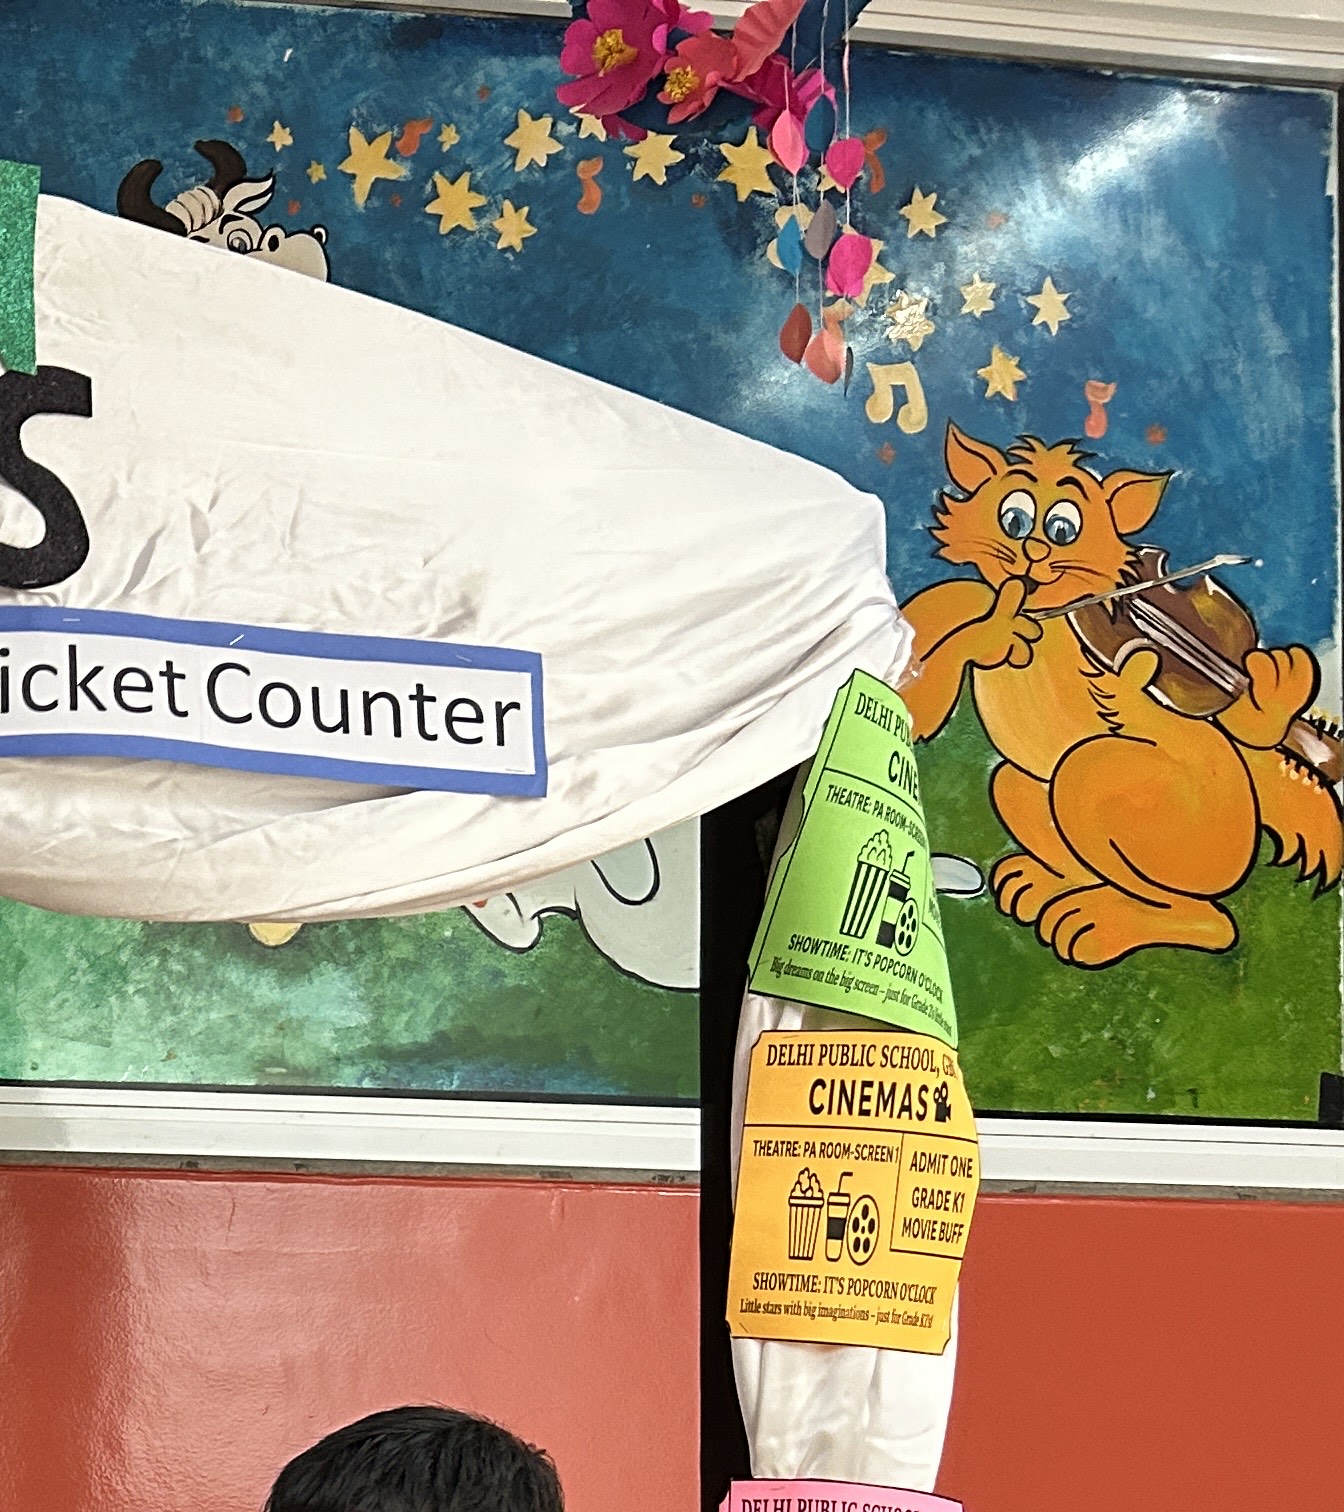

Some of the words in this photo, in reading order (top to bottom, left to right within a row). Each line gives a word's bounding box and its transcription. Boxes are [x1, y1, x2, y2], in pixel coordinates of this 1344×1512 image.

[206, 662, 521, 746] Counter
[855, 692, 894, 732] DELHI
[825, 784, 872, 813] THEATRE:
[872, 800, 884, 819] PA
[788, 934, 851, 962] SHOWTIME:
[852, 949, 873, 968] IT'S
[873, 954, 918, 983] POPCORN
[766, 1044, 815, 1067] DELHI
[817, 1044, 876, 1067] PUBLIC
[880, 1045, 940, 1078] SCHOOL,
[809, 1078, 929, 1121] CINEMAS
[753, 1140, 802, 1158] THEATRE:
[803, 1142, 817, 1159] PA
[819, 1143, 892, 1163] ROOM-SCREEN
[910, 1151, 948, 1176] ADMIT
[951, 1156, 973, 1178] ONE
[912, 1187, 951, 1210] GRADE
[953, 1192, 966, 1214] K1
[902, 1217, 938, 1241] MOVIE
[939, 1222, 964, 1244] BUFF
[753, 1272, 821, 1293] SHOWTIME:
[823, 1275, 845, 1295] IT'S
[847, 1278, 899, 1299] POPCORN
